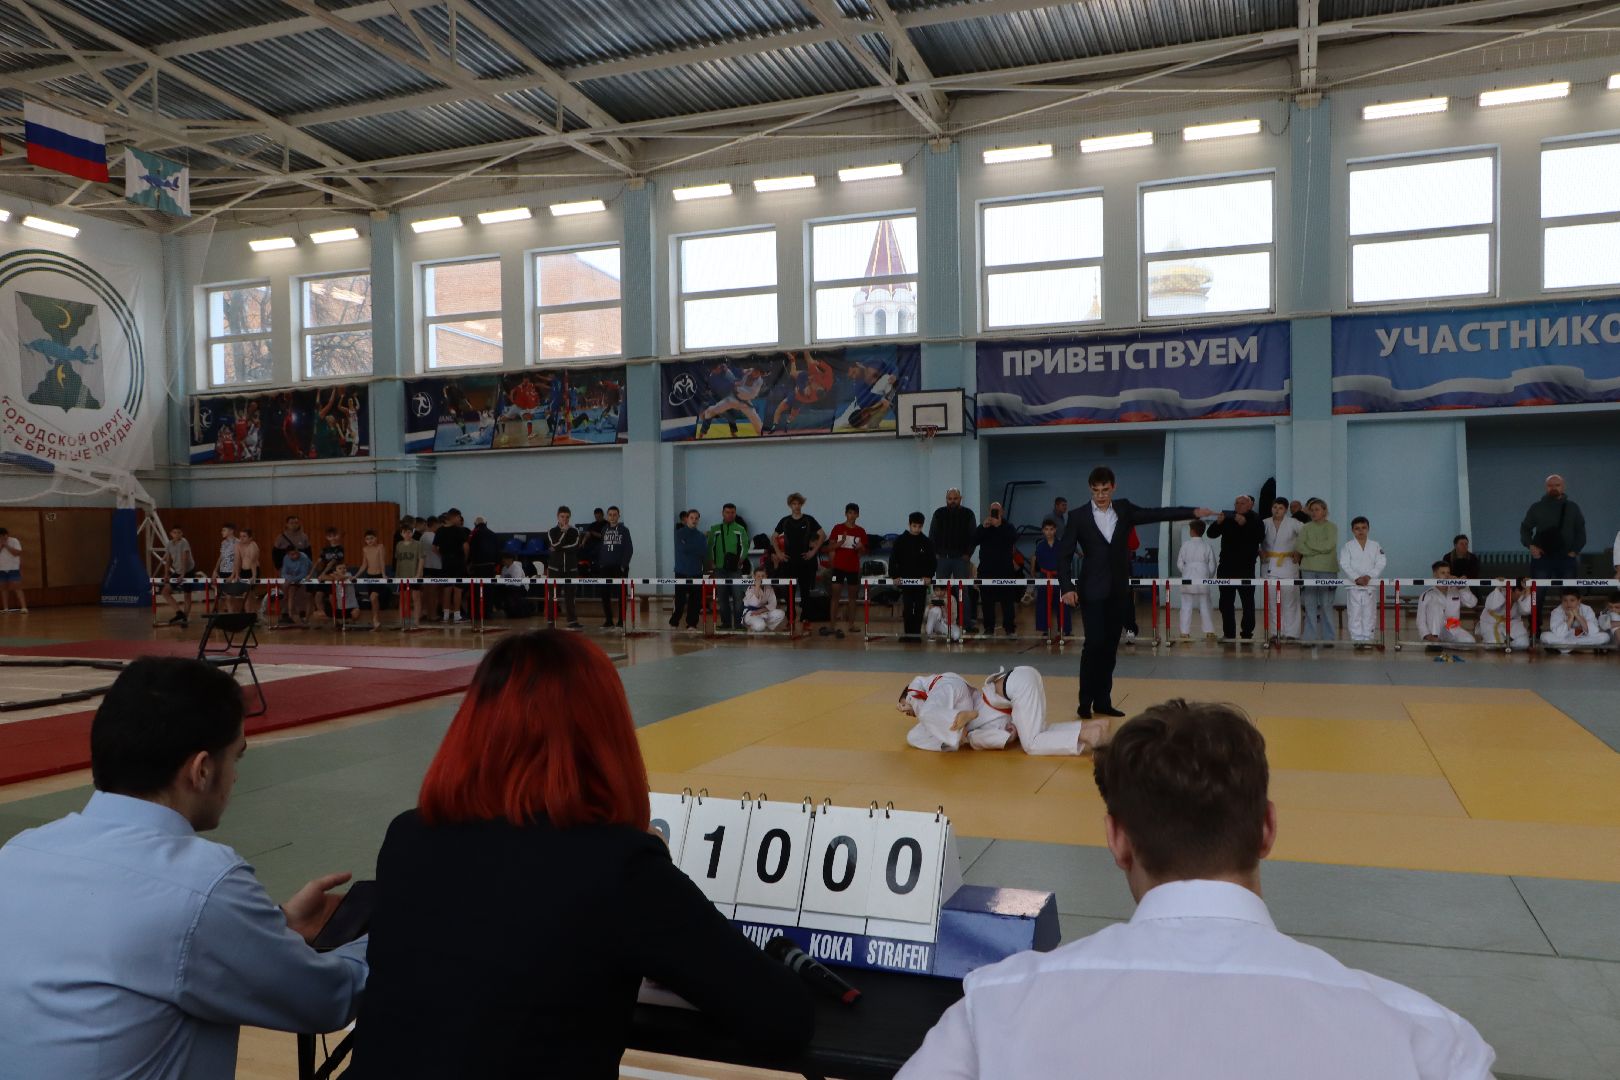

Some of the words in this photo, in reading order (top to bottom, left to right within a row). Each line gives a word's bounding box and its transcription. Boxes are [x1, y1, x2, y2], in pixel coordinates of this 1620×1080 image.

[1375, 312, 1620, 357] УЧАСТНИКО
[1003, 335, 1257, 376] ПРИВЕТСТВУЕМ
[90, 409, 124, 442] ОКРУГ
[95, 418, 133, 457] ПРУДЫ
[703, 825, 726, 879] 1
[756, 828, 791, 884] 0
[822, 835, 858, 892] 0
[885, 836, 922, 895] 0
[808, 932, 853, 962] KOKA
[866, 939, 930, 971] STRAFEN
